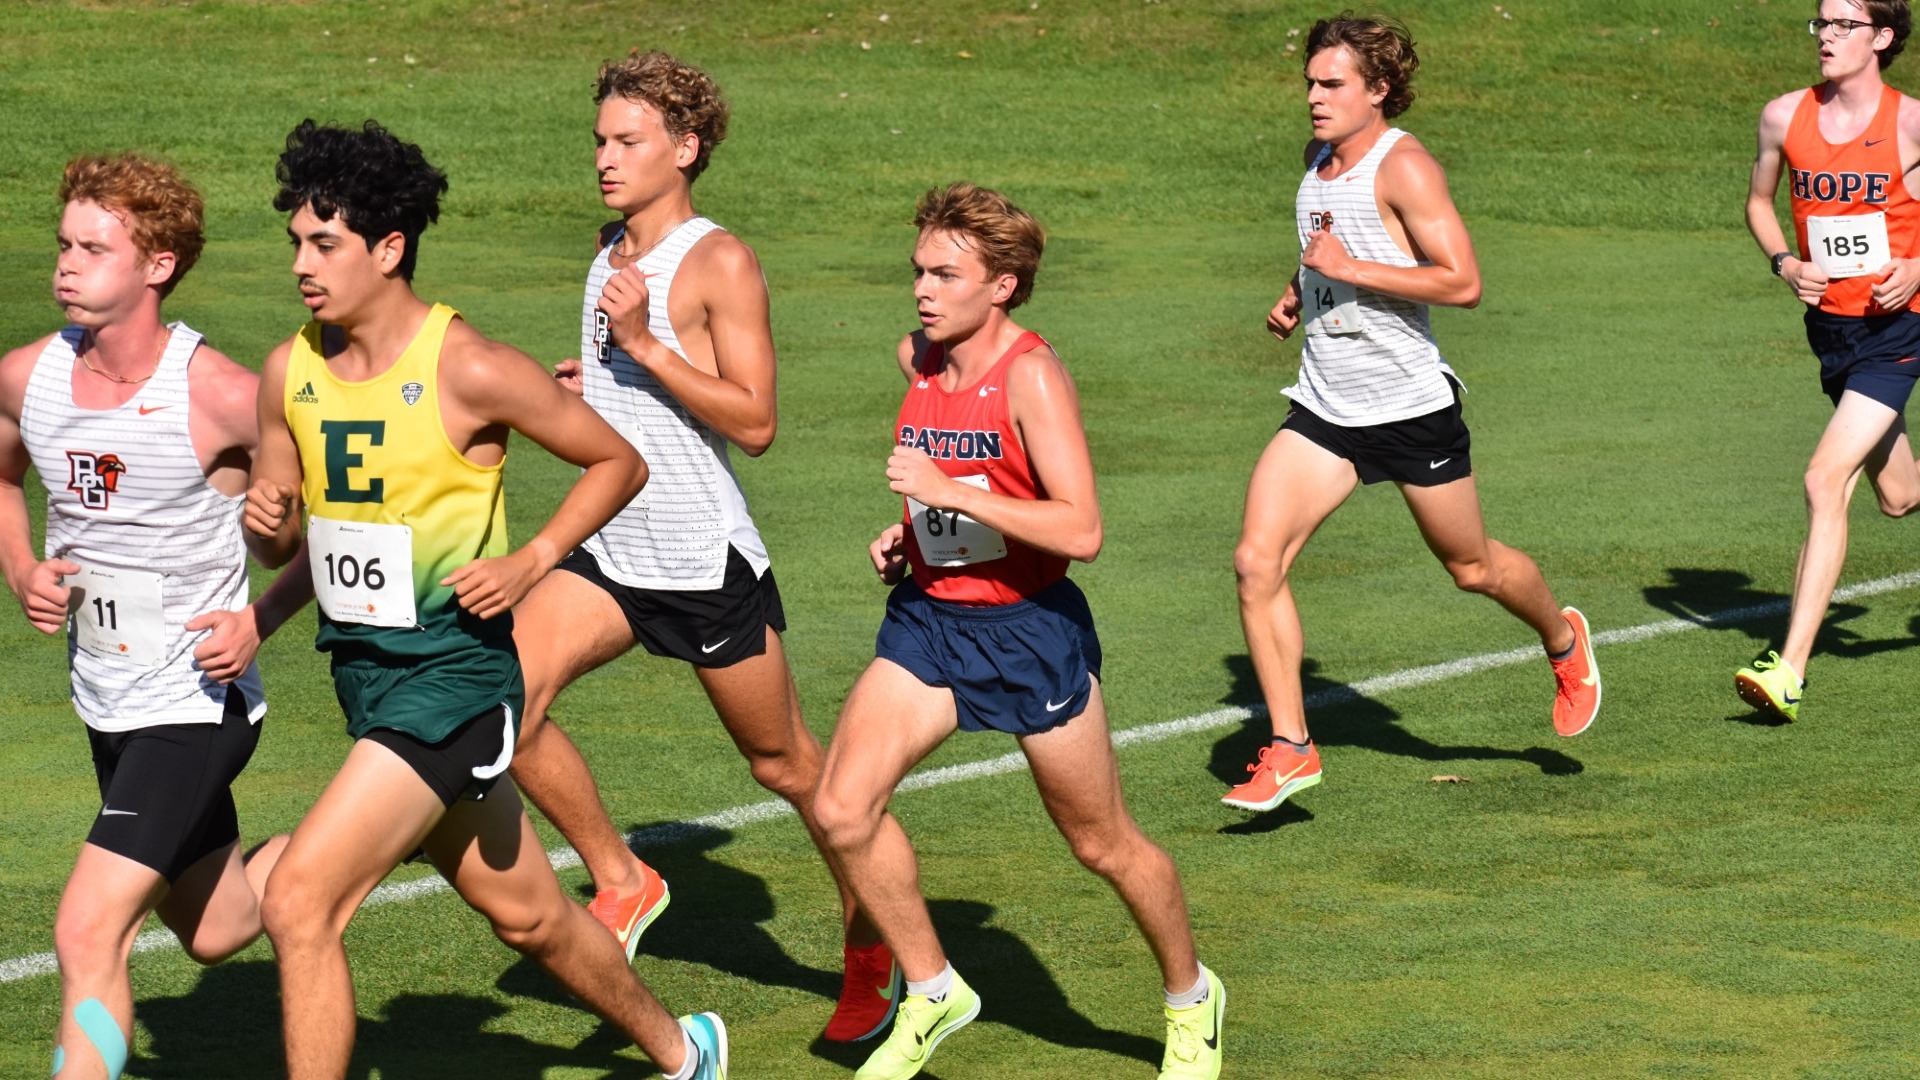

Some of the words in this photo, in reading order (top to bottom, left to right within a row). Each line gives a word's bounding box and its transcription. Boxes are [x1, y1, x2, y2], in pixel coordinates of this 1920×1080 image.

[1791, 168, 1890, 204] HOPE
[1823, 234, 1870, 257] 185
[1314, 286, 1335, 310] 14
[320, 420, 385, 503] E
[926, 507, 960, 536] 87
[325, 553, 385, 590] 106
[93, 597, 117, 630] 11
